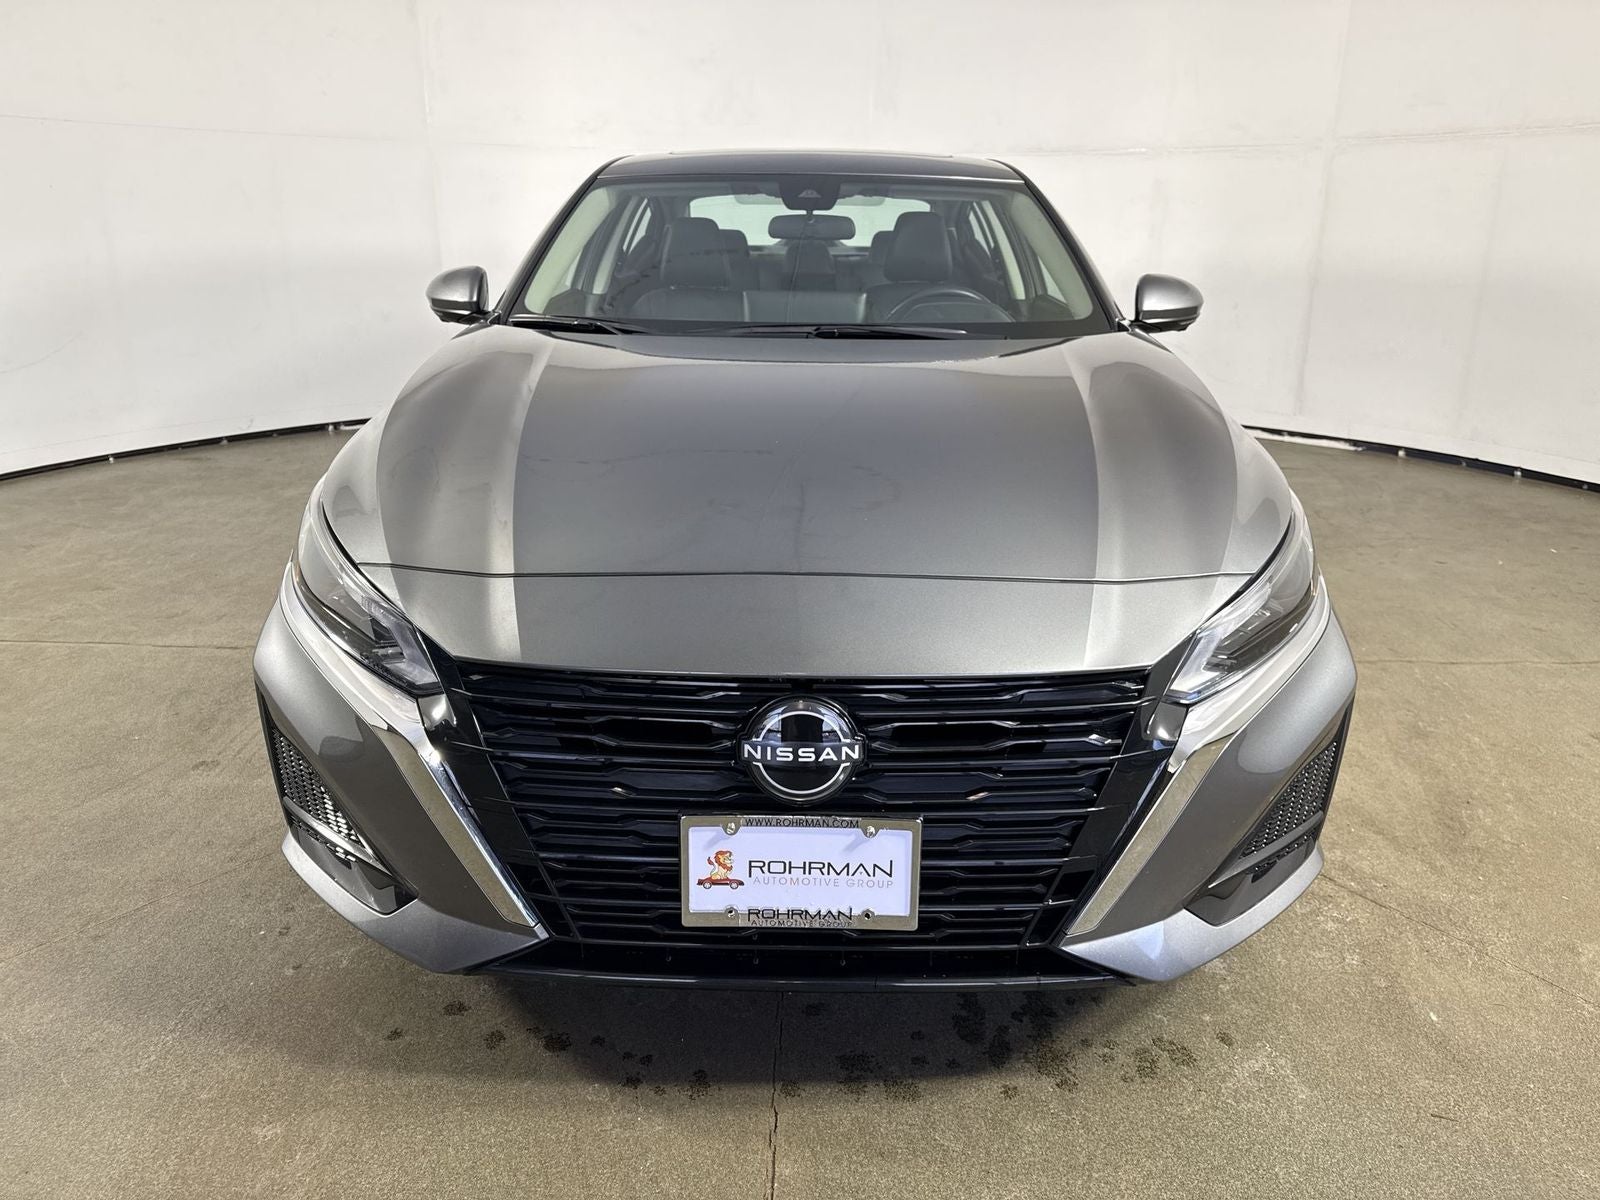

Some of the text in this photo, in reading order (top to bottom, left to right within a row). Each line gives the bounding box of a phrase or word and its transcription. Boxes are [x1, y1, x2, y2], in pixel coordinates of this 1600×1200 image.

[743, 744, 859, 762] NISSAN
[745, 818, 859, 829] WWW.ROHRMAN.COM
[748, 860, 893, 878] ROHRMAN
[753, 877, 894, 889] AUTOMOTIVE GROUP
[748, 907, 852, 922] ROHRMAN
[751, 919, 853, 928] AUTOMOTIVE GROUP
